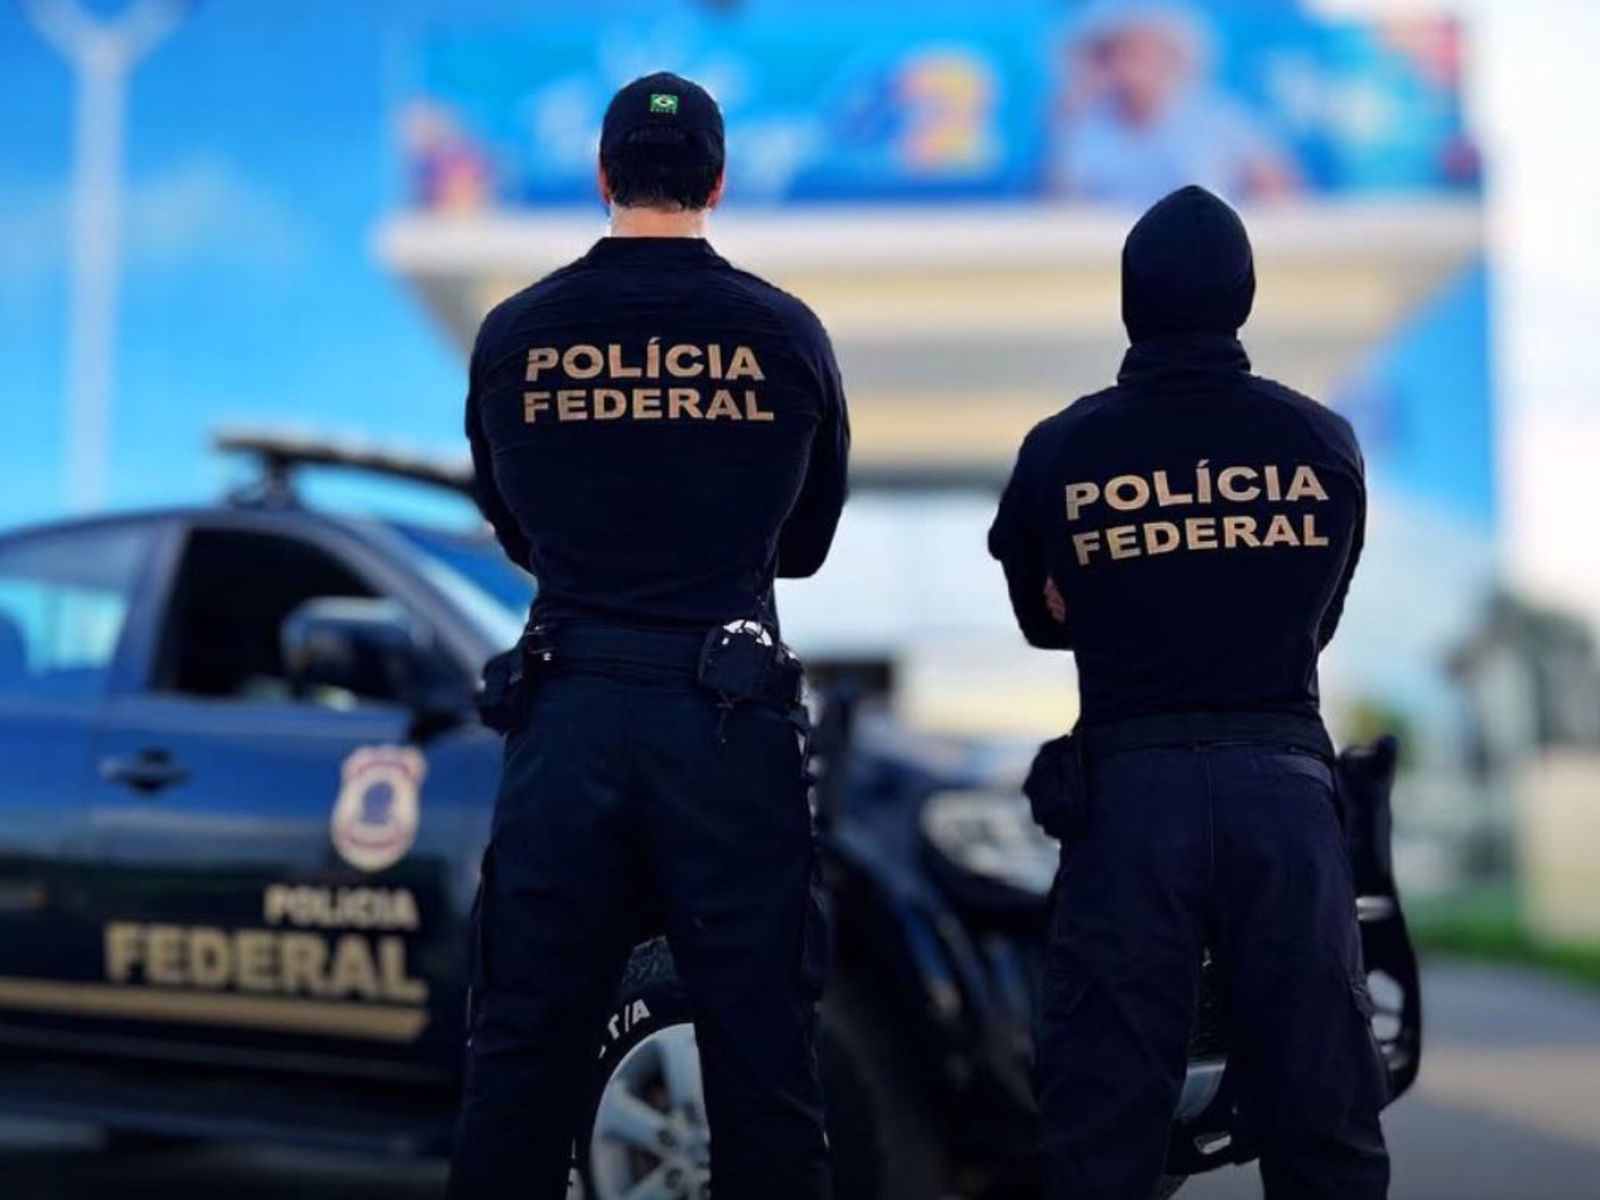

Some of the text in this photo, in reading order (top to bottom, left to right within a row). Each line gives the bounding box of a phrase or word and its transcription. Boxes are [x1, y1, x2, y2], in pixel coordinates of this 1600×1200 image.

[525, 337, 765, 381] POLÍCIA
[524, 388, 774, 423] FEDERAL
[1065, 459, 1329, 521] POLÍCIA
[1072, 514, 1329, 565] FEDERAL
[105, 922, 427, 1000] FEDERAL
